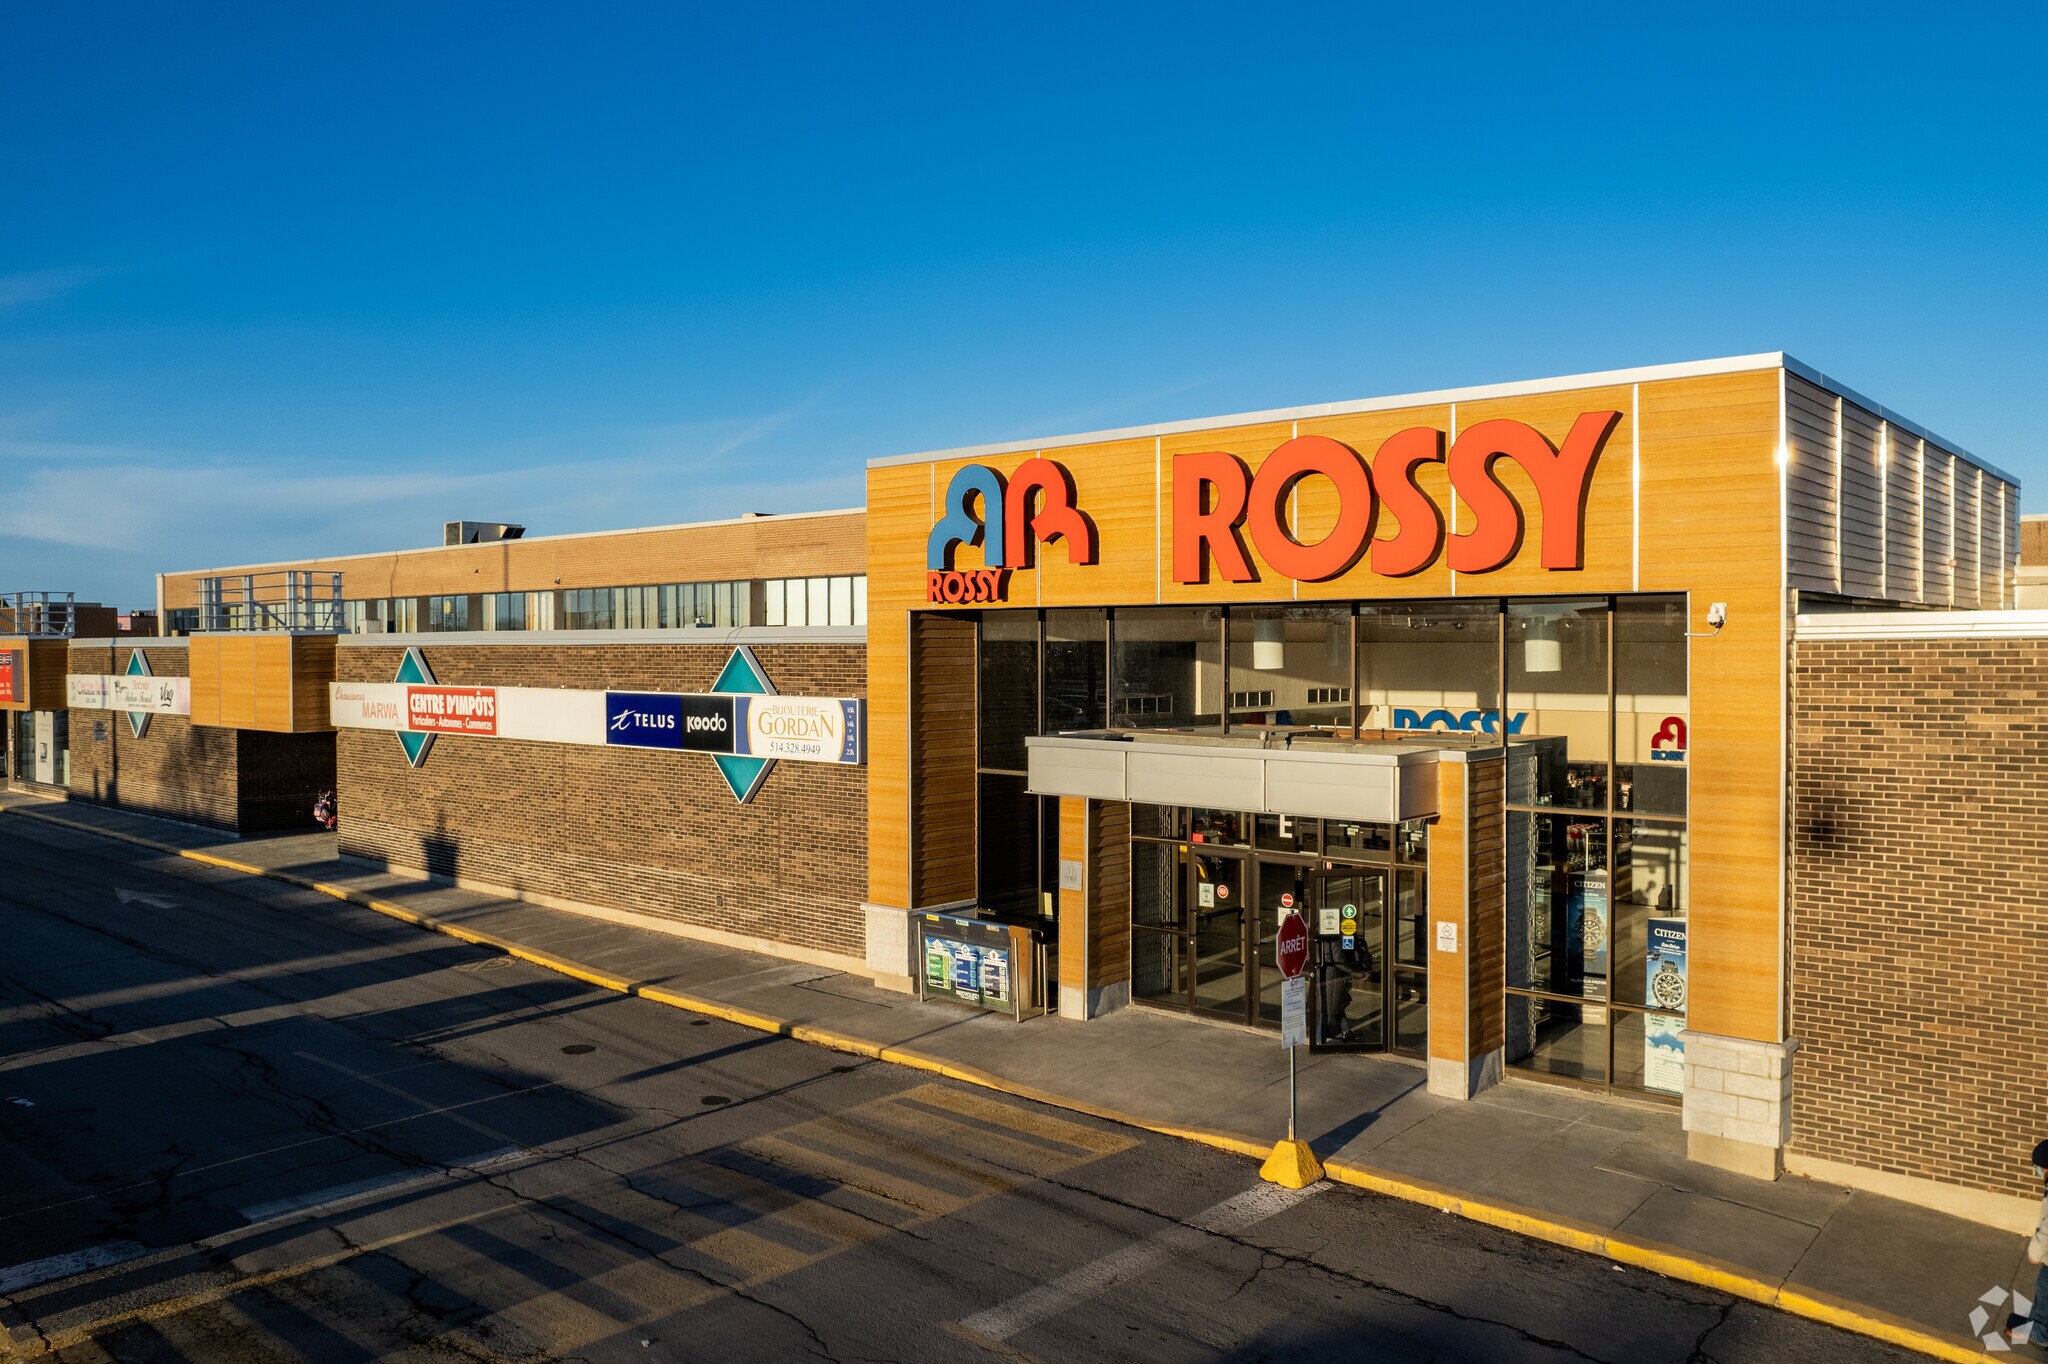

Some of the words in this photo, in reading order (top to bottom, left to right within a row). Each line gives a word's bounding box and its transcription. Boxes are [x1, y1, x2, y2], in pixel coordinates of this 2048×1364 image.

[1173, 410, 1622, 583] ROSSY
[927, 568, 1003, 602] ROSSY
[362, 702, 399, 719] MARWA
[410, 693, 444, 714] CENTRE
[446, 690, 495, 717] D'IMPÔTS
[772, 705, 819, 716] BIJOUTERIE
[412, 715, 436, 727] Particuliers
[438, 717, 463, 729] Autonomes
[465, 717, 493, 730] Commerces
[634, 713, 675, 729] TELUS
[758, 711, 834, 738] GORDAN
[769, 742, 821, 755] 514.328.4949
[1574, 880, 1606, 889] CITIZEN
[1654, 928, 1687, 941] CITIZEN
[1280, 935, 1306, 956] ARRÊT
